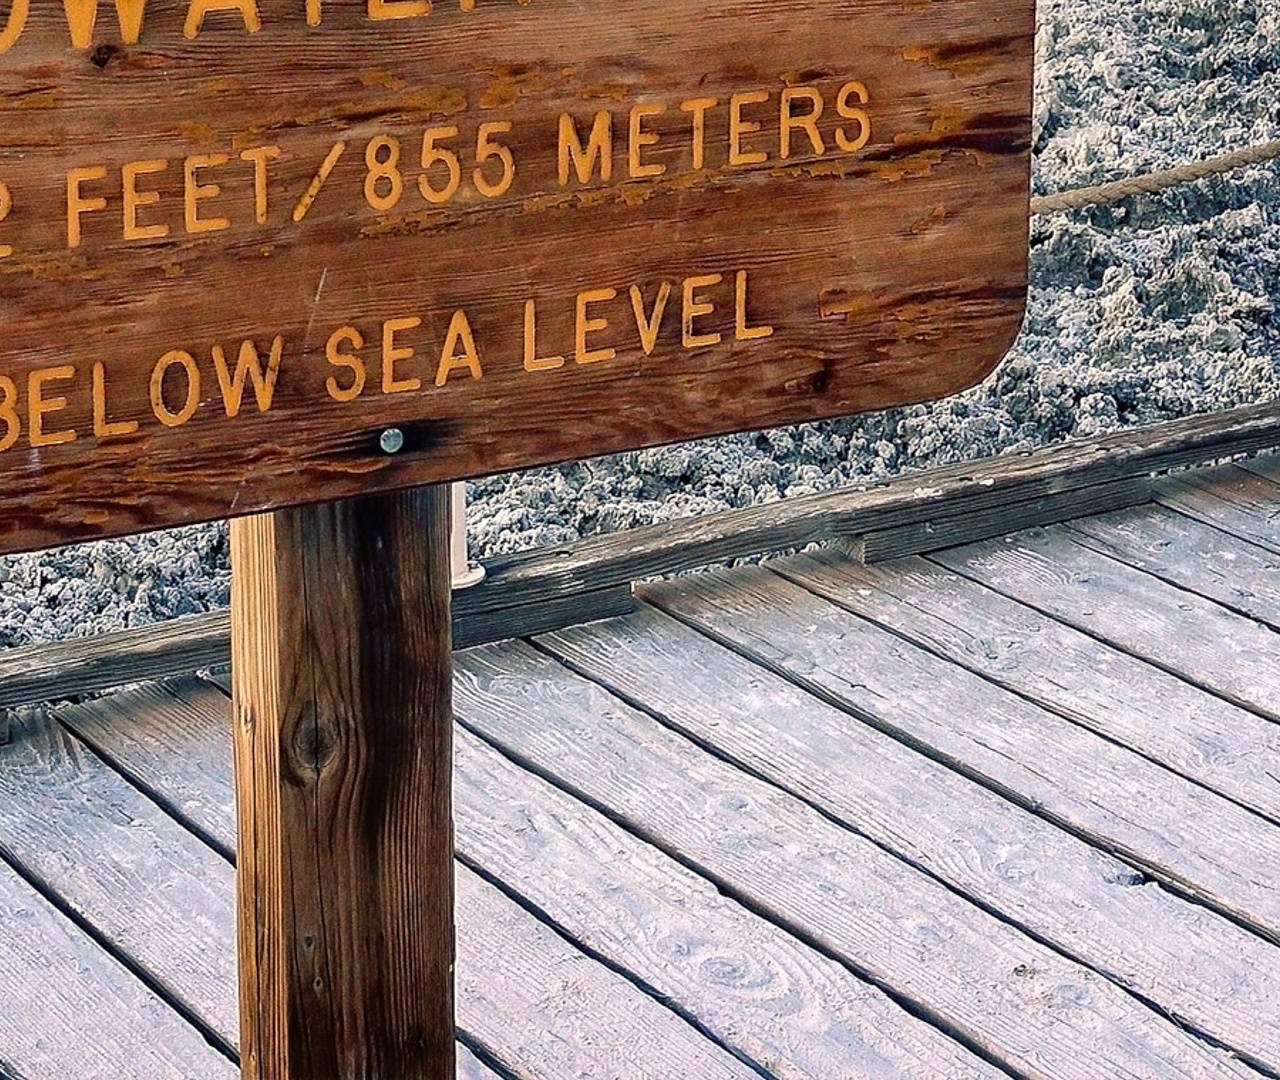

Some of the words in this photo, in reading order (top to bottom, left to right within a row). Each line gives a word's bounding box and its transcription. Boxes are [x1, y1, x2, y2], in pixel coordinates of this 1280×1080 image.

[557, 82, 872, 186] METERS
[325, 312, 483, 402] SEA
[522, 271, 774, 373] LEVEL
